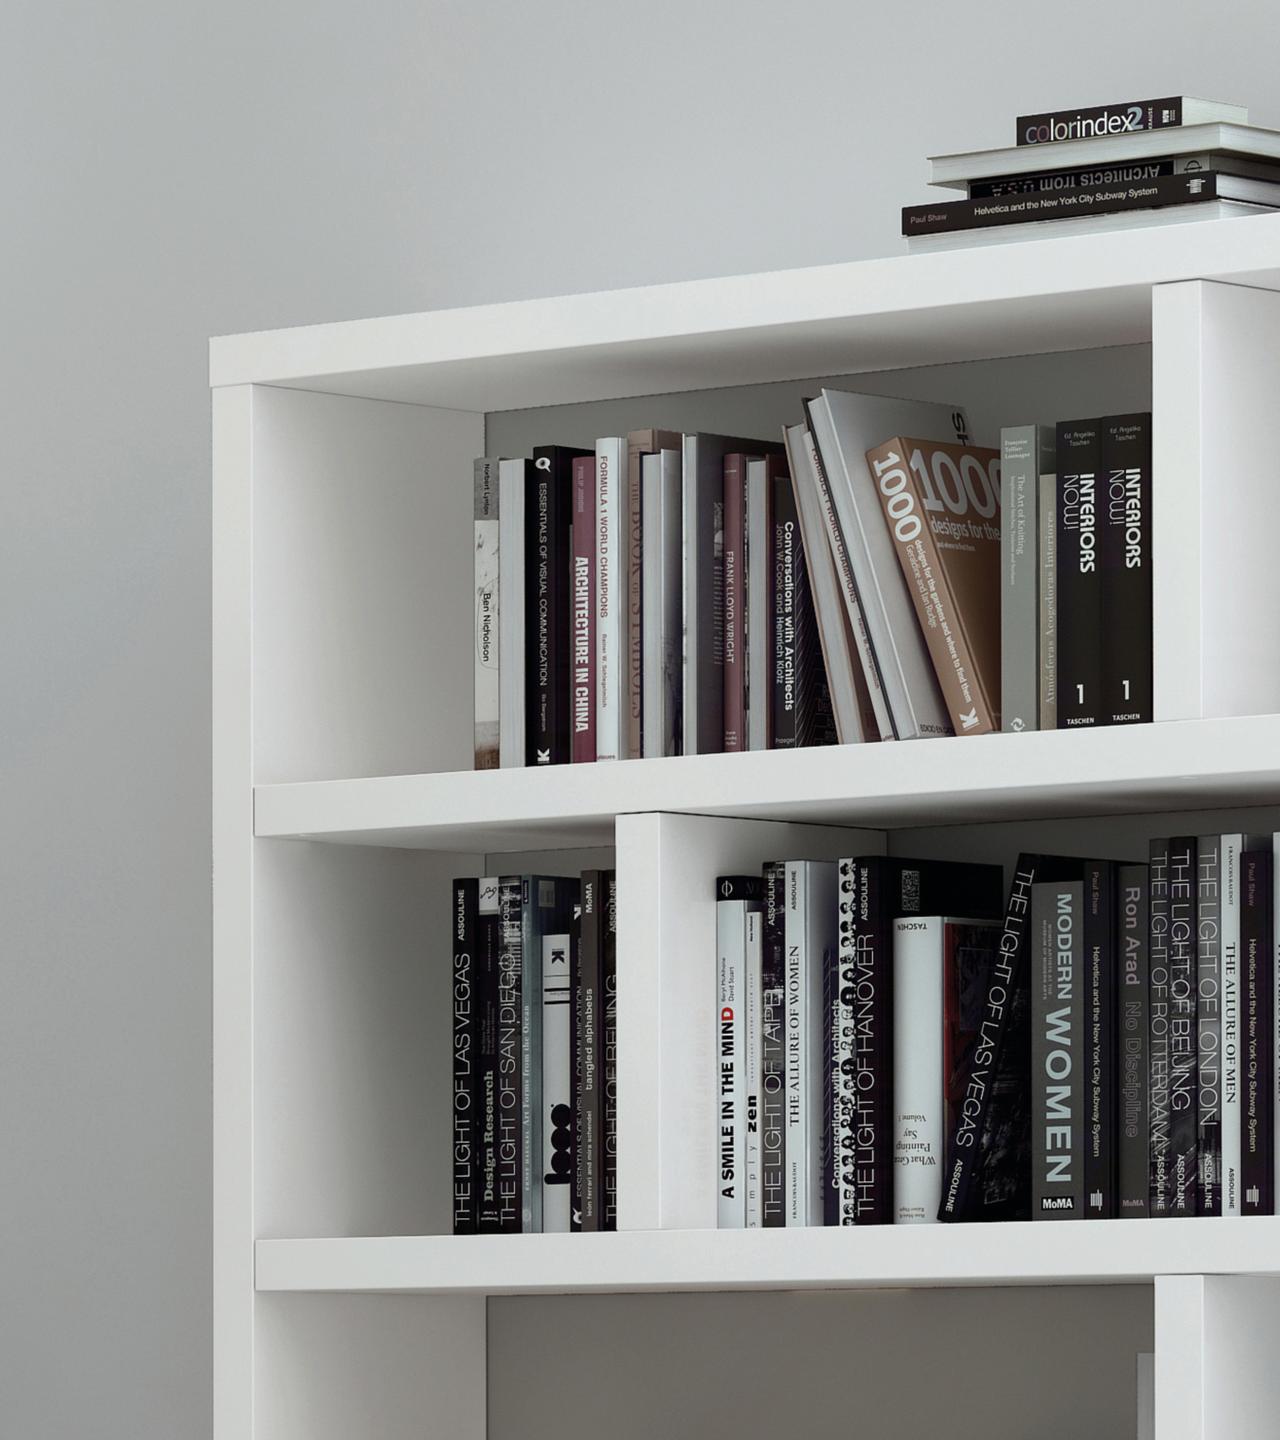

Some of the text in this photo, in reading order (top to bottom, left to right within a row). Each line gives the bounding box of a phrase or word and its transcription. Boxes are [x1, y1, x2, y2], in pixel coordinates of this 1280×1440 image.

[974, 187, 1157, 215] Helvetica and the New York City Subway System
[872, 451, 922, 542] 1000
[1063, 475, 1079, 530] NOW!
[1079, 473, 1095, 573] INTERIORS
[1109, 469, 1125, 525] NOW!
[1126, 468, 1141, 569] INTERIORS
[575, 557, 588, 731] ARCHITECTURE IN CHINA
[726, 551, 735, 664] FRANK LLOYD WRIGHT
[784, 521, 793, 710] Conversations with Architects
[1066, 717, 1094, 725] TASCHEN
[1076, 684, 1084, 704] 1
[1112, 713, 1141, 722] TASCHEN
[1122, 680, 1129, 700] 1
[1057, 893, 1072, 998] MODERN
[1125, 887, 1140, 984] Ron Arad
[789, 946, 800, 1127] THE ALLURE OF WOMEN
[856, 934, 874, 1216] THE LIGHT OF HANOVER
[454, 953, 470, 1225] THE LIGHT OF LAS VEGAS
[483, 1070, 495, 1200] Design Research
[721, 1007, 734, 1198] A SMILE IN THE MIND
[747, 1095, 758, 1132] zen
[1045, 1006, 1071, 1181] WOMEN
[1043, 1198, 1073, 1210] MoMA
